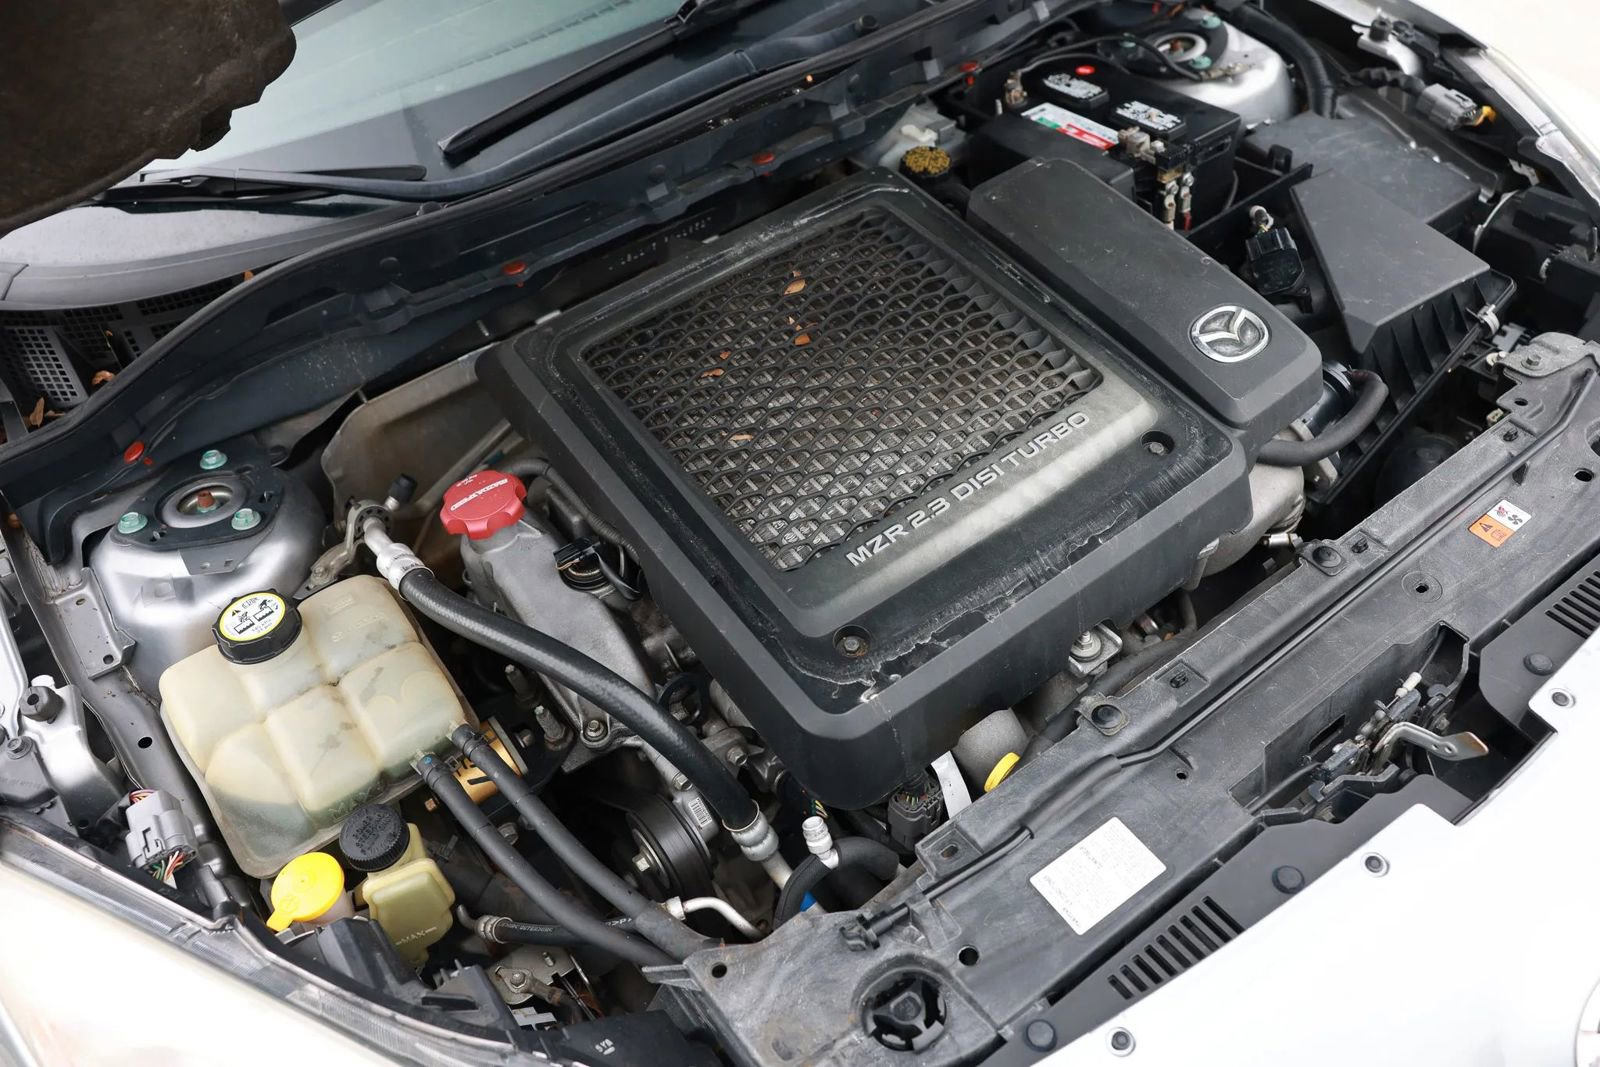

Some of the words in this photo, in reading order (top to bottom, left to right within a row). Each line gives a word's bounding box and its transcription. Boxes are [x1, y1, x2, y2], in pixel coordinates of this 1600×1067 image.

[846, 523, 909, 567] MZR
[907, 497, 951, 529] 2.3
[951, 463, 1005, 502] DISI
[1001, 411, 1090, 467] TURBO
